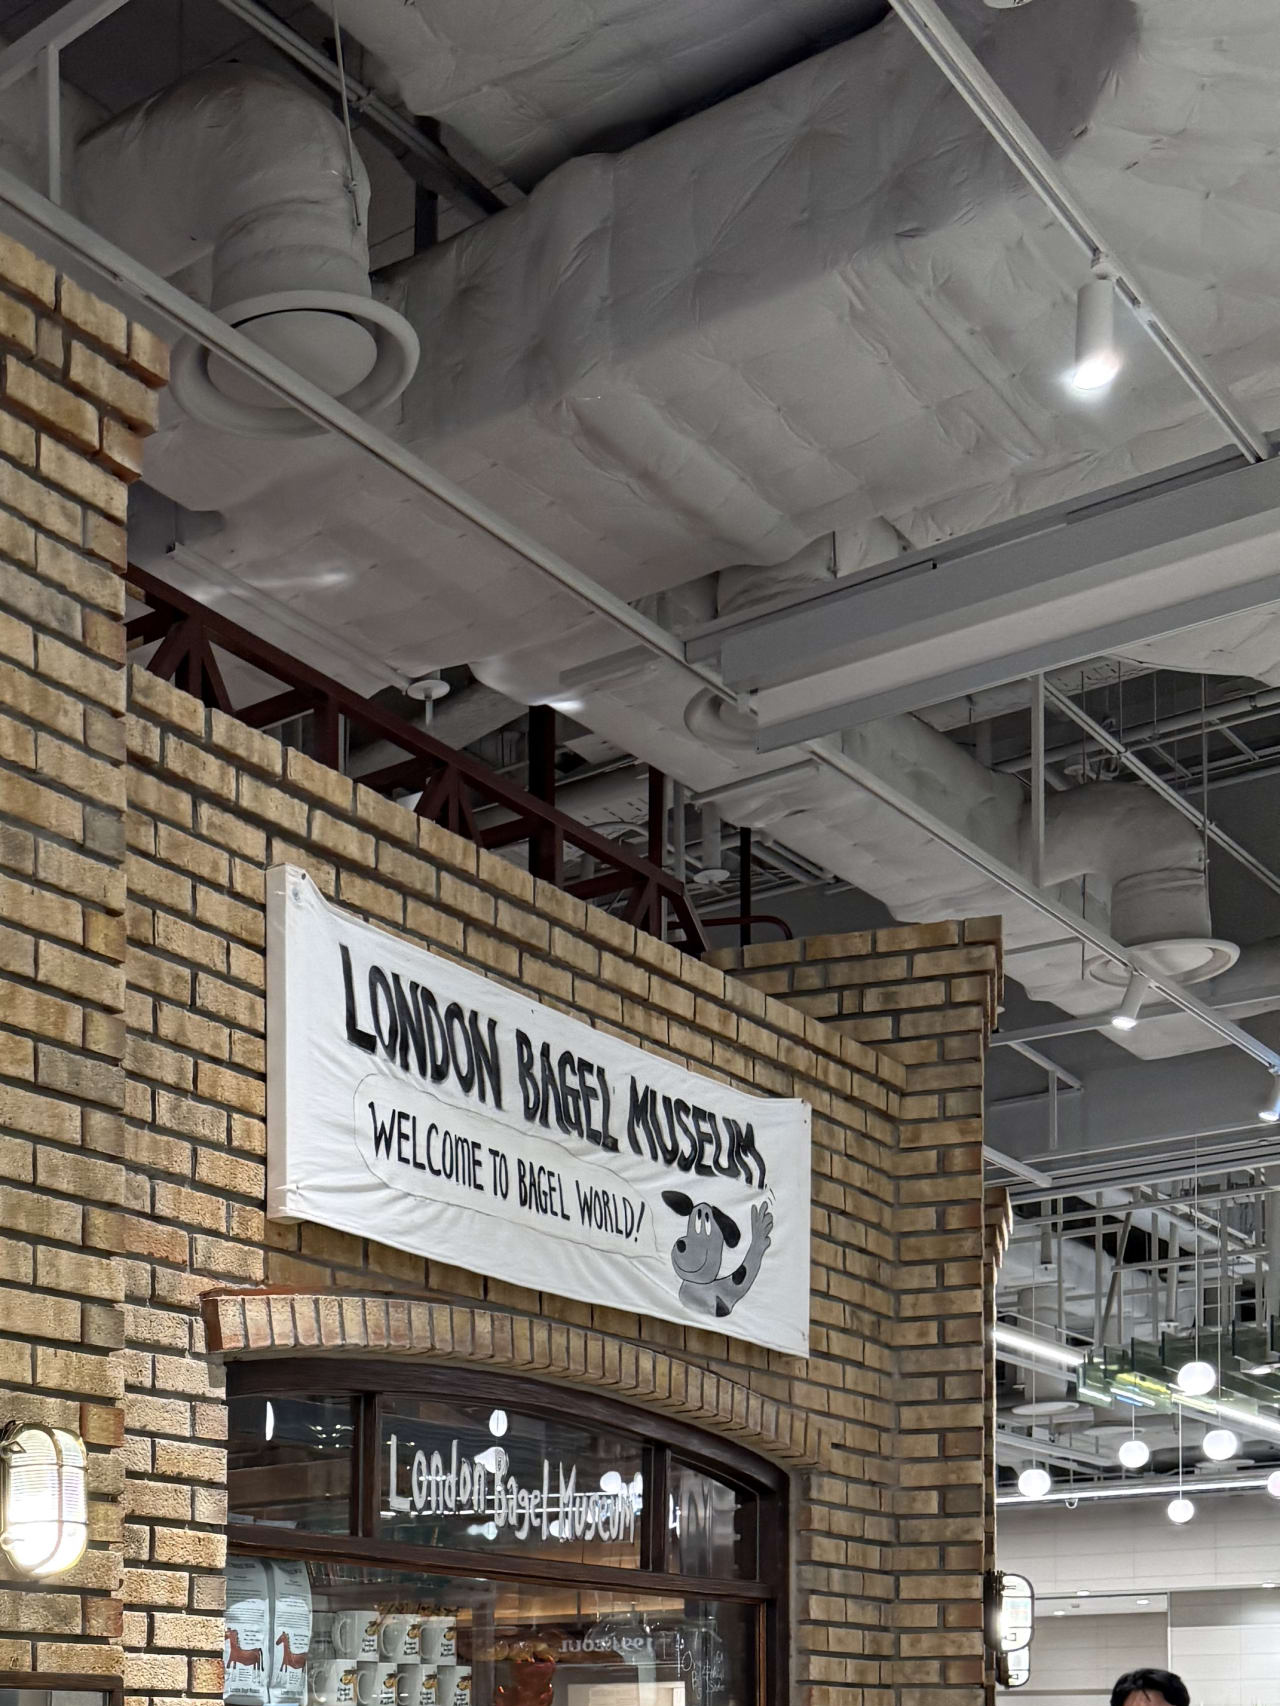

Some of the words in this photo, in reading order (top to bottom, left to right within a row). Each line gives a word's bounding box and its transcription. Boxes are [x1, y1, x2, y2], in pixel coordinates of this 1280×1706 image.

[338, 943, 504, 1110] LONDON
[515, 1028, 620, 1152] BAGEL
[368, 1101, 484, 1191] WELCOME
[488, 1147, 510, 1200] TO
[517, 1158, 571, 1221] BAGEL
[575, 1179, 646, 1243] WORLD!
[389, 1433, 487, 1514] London
[494, 1447, 550, 1541] Bagel
